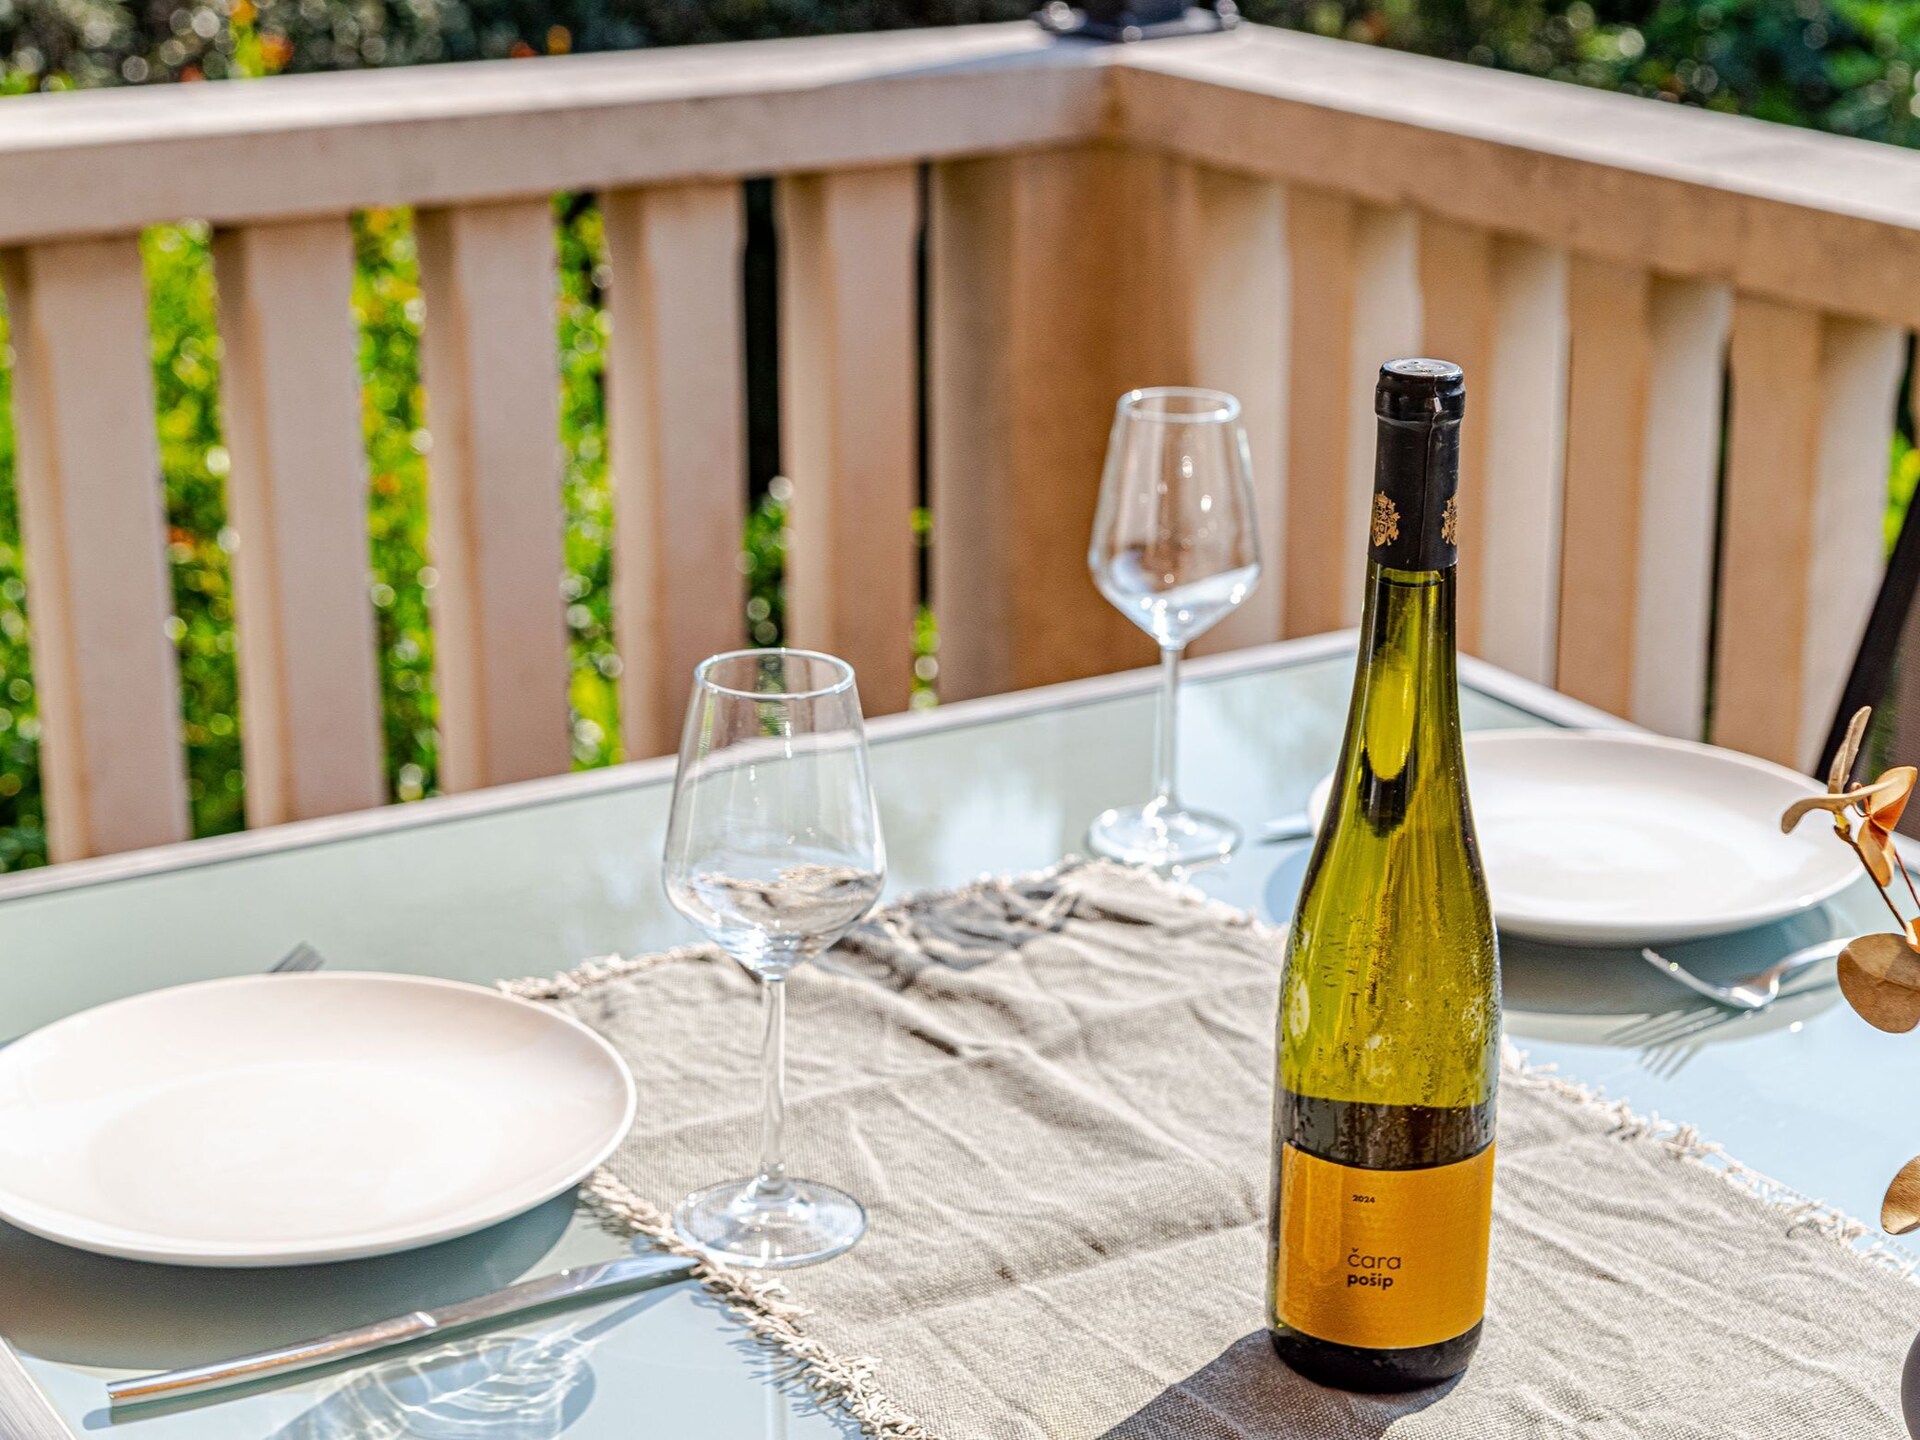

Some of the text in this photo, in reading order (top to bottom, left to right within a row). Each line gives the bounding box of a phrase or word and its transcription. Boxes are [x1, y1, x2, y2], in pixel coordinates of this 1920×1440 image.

[1352, 1194, 1375, 1204] 2024
[1347, 1248, 1401, 1270] čara
[1347, 1273, 1394, 1290] pošip
